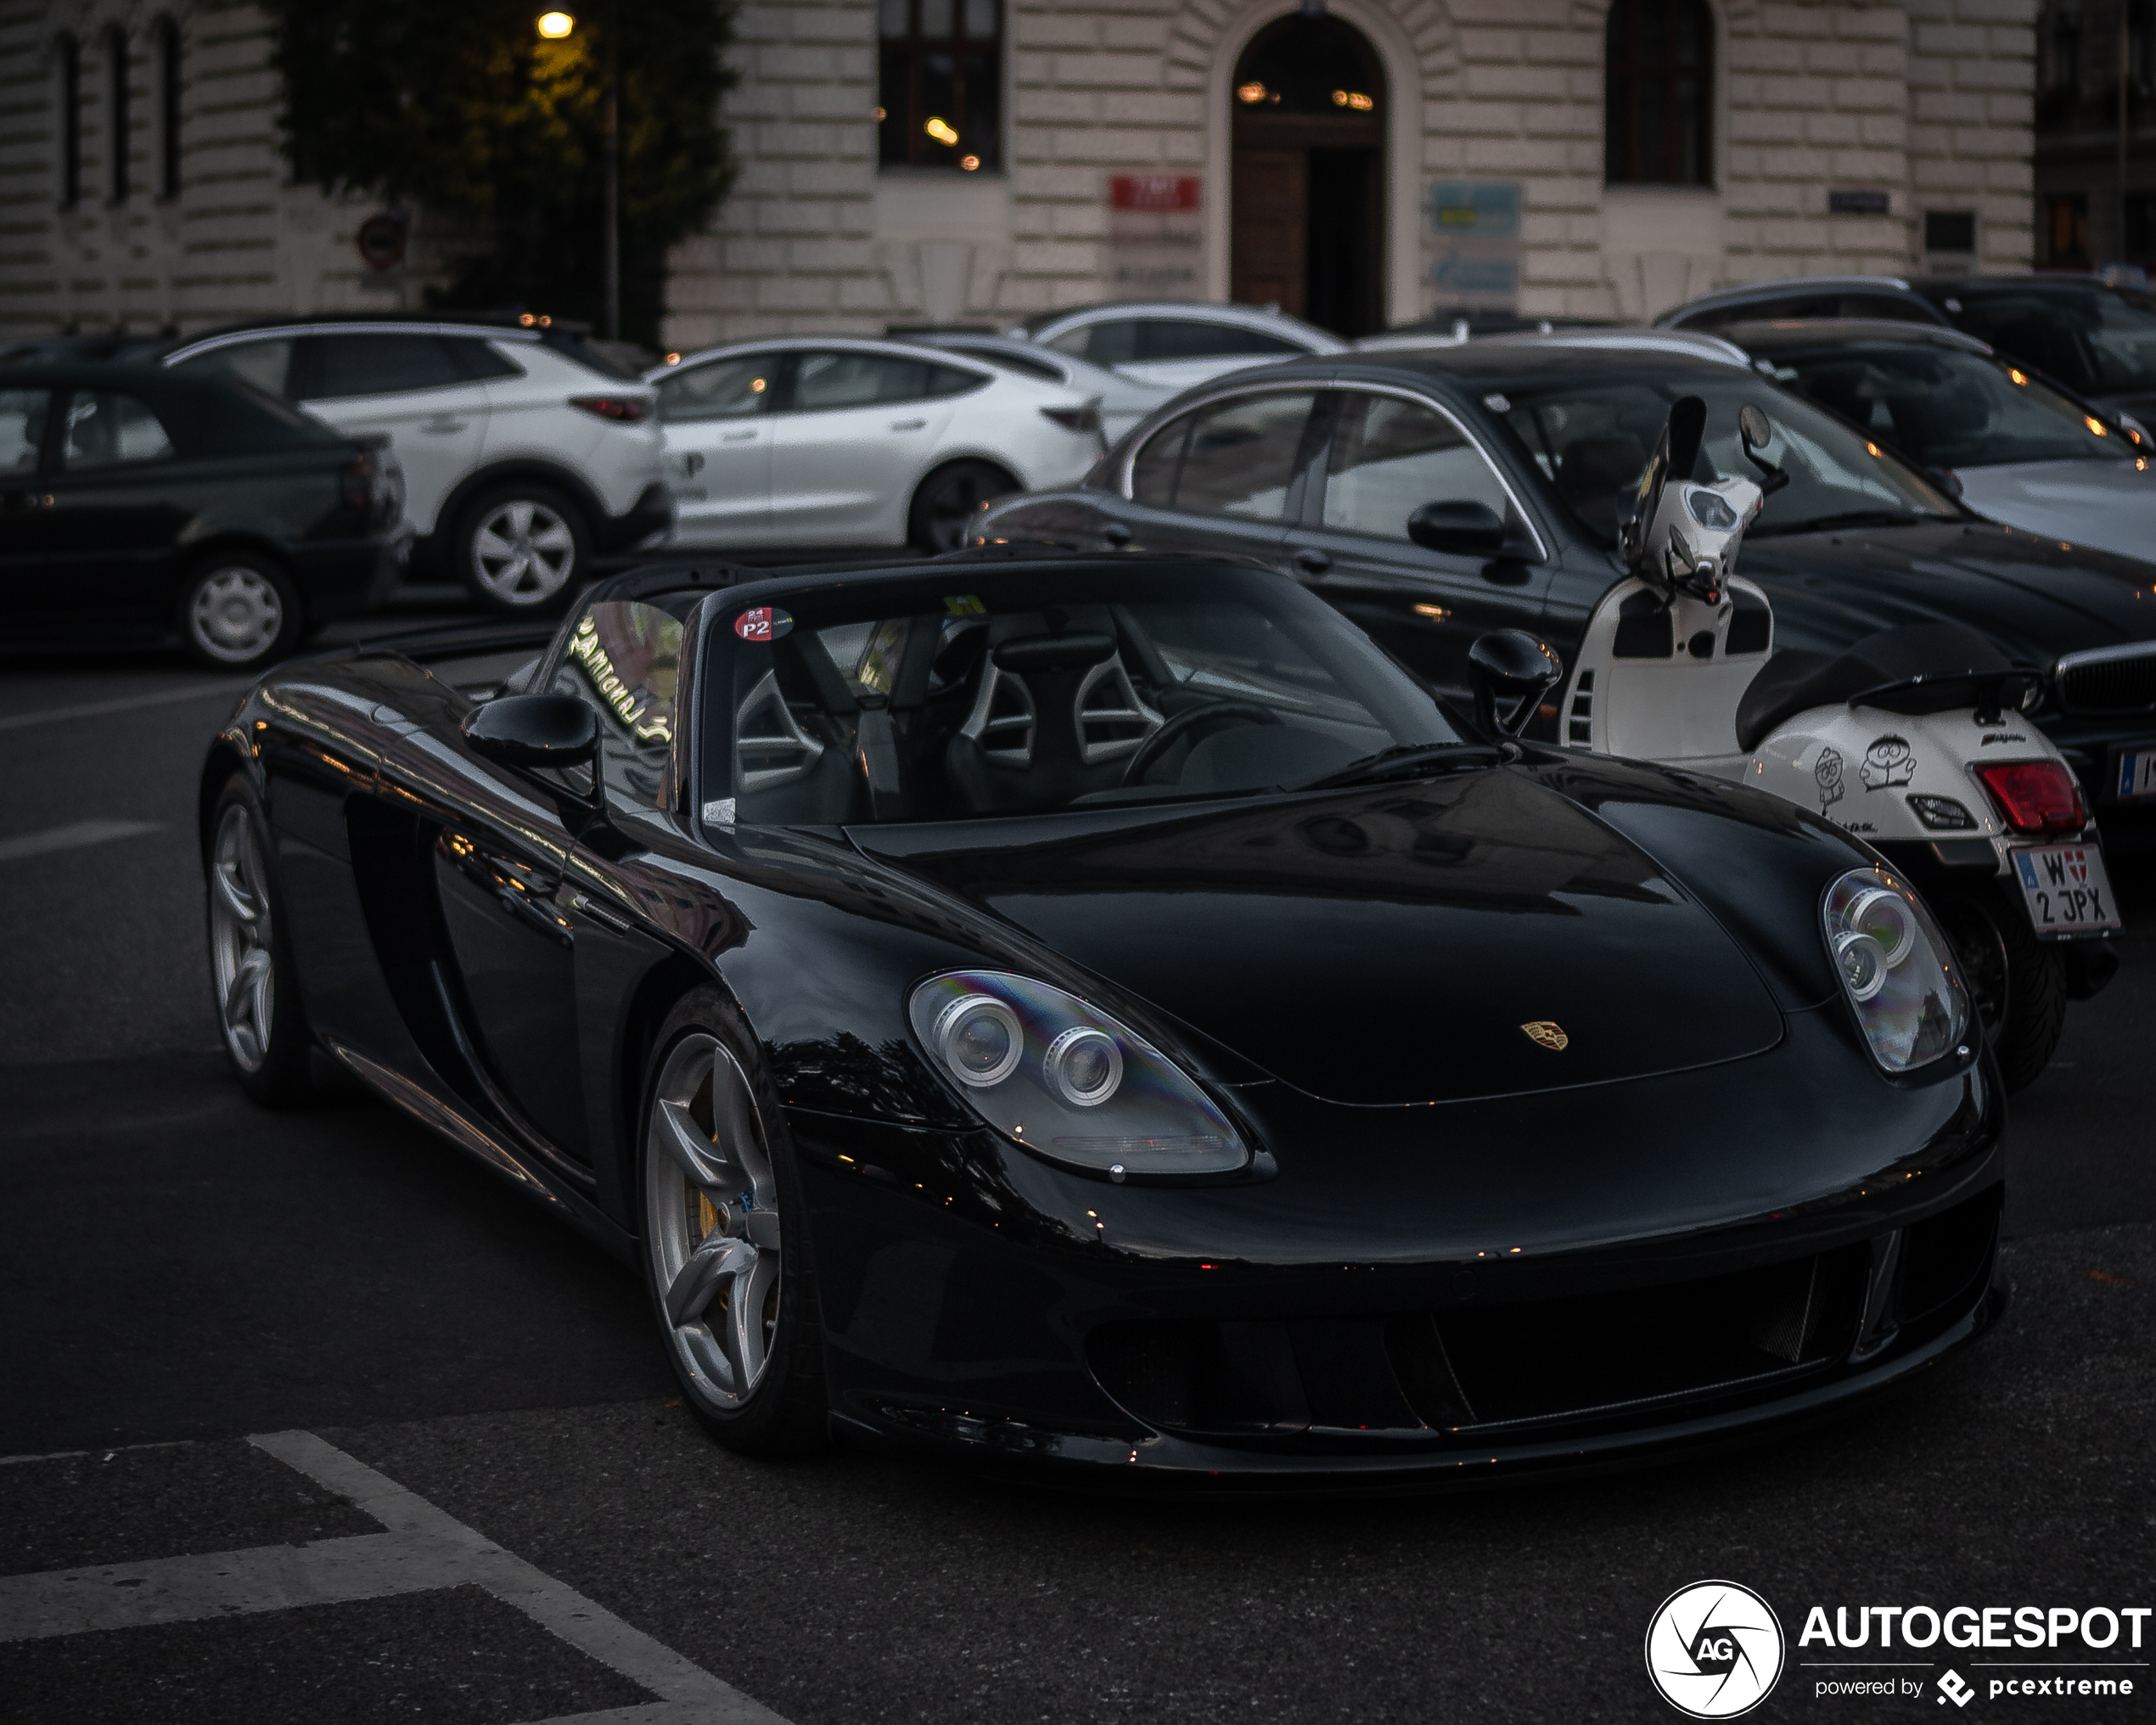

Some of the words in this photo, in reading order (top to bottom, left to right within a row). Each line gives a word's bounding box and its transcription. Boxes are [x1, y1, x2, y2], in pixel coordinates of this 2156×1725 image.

[743, 621, 770, 638] P2
[2043, 853, 2065, 885] W
[2036, 892, 2055, 922] 2
[2058, 888, 2106, 922] JPX
